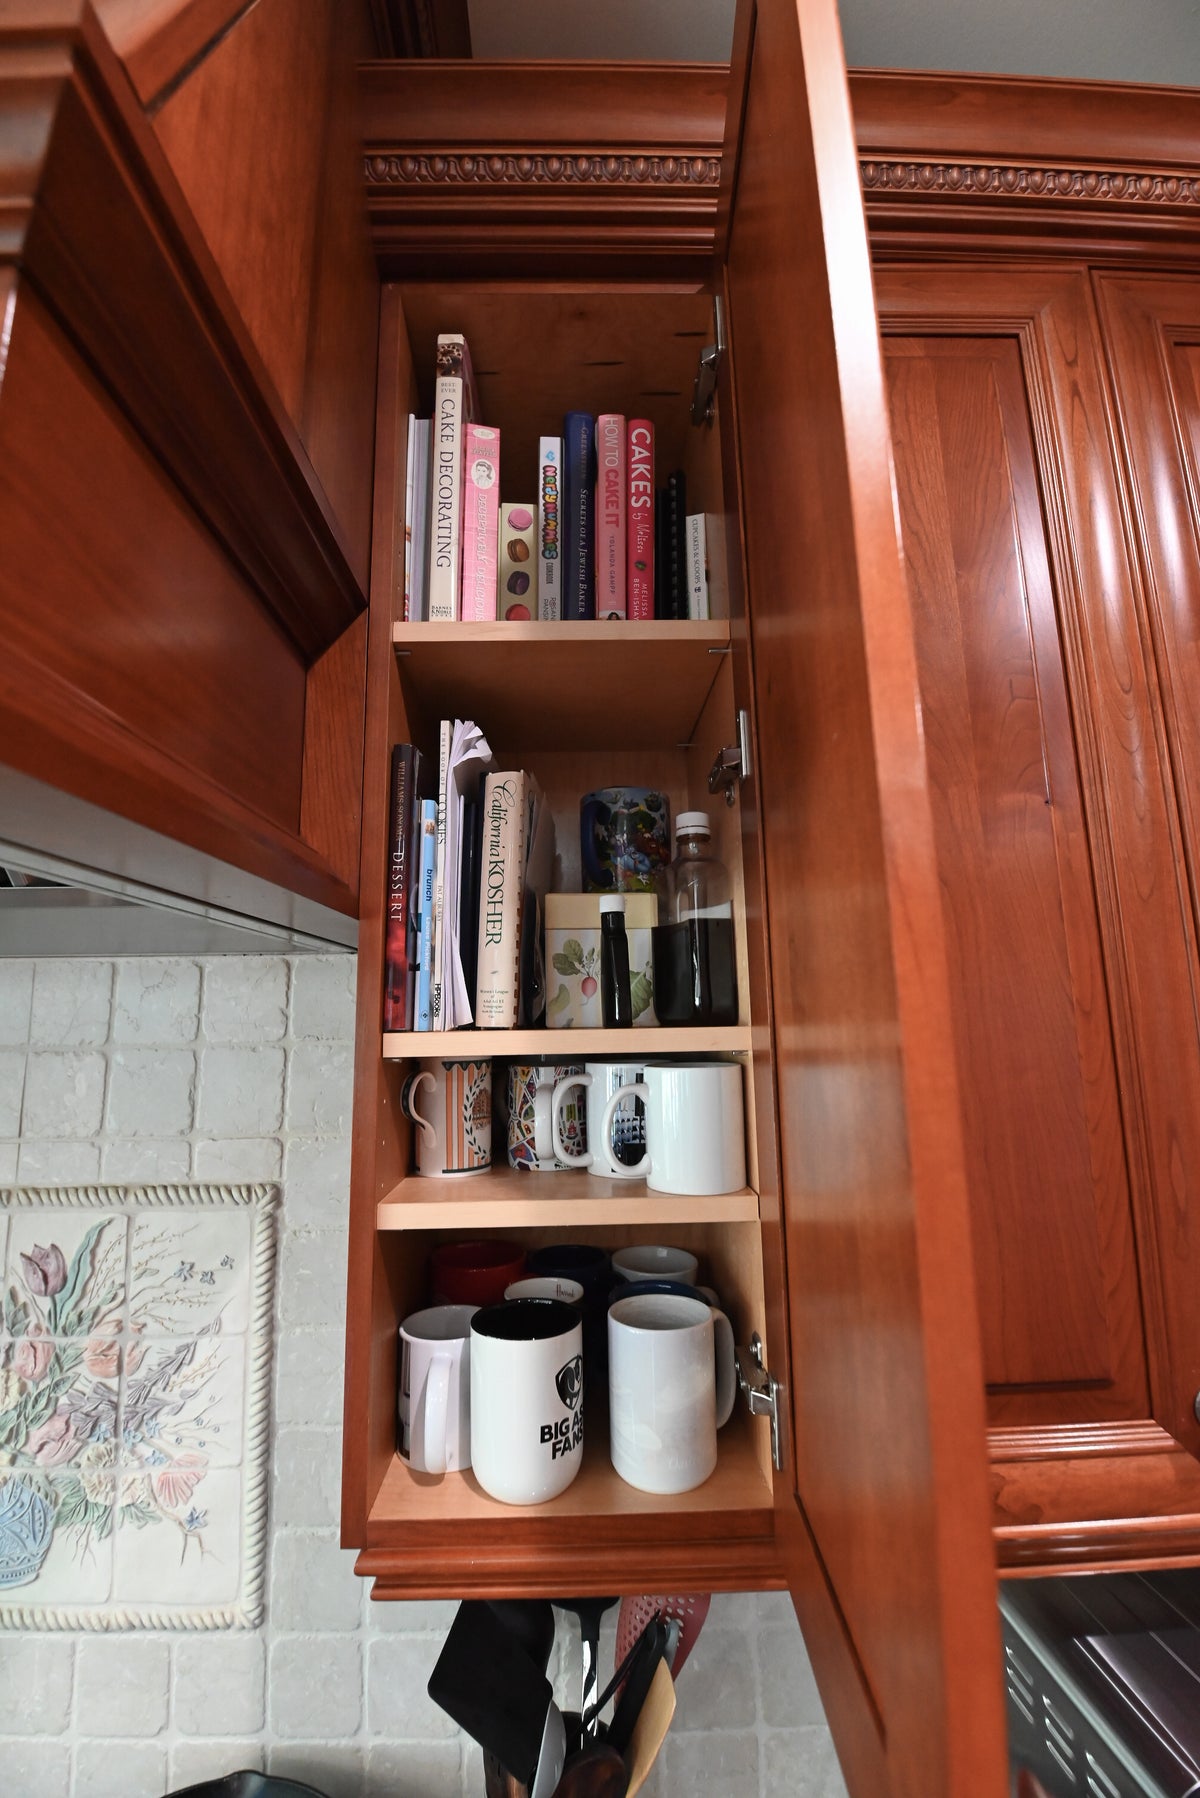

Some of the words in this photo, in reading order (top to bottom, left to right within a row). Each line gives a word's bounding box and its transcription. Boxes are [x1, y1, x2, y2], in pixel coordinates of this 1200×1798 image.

[441, 399, 456, 443] CAKE
[605, 417, 619, 447] HOW
[605, 450, 619, 467] TO
[631, 428, 651, 508] CAKES
[605, 469, 620, 510] CAKE
[436, 451, 455, 568] DECORATING
[579, 488, 589, 525] SECRETS
[605, 513, 620, 528] IT
[632, 512, 648, 520] by
[476, 494, 489, 564] DECEPTIVELY
[636, 523, 651, 553] Melissa
[692, 518, 700, 551] CUPCAKES
[546, 562, 554, 585] COOKBOOK
[578, 548, 588, 580] JEWISH
[694, 559, 702, 585] SCOOPS
[474, 567, 486, 621] DELICIOUS
[578, 583, 588, 613] BAKER
[633, 578, 641, 621] BEN-ISHAY
[641, 583, 649, 616] MELISSA
[441, 776, 446, 786] OF
[437, 793, 447, 845] COOKIES
[487, 780, 517, 857] California
[391, 852, 404, 922] DESSERT
[425, 869, 433, 902] brunch
[484, 859, 505, 948] KOSHER
[434, 983, 442, 1018] HPBooks
[540, 1417, 570, 1444] BIG
